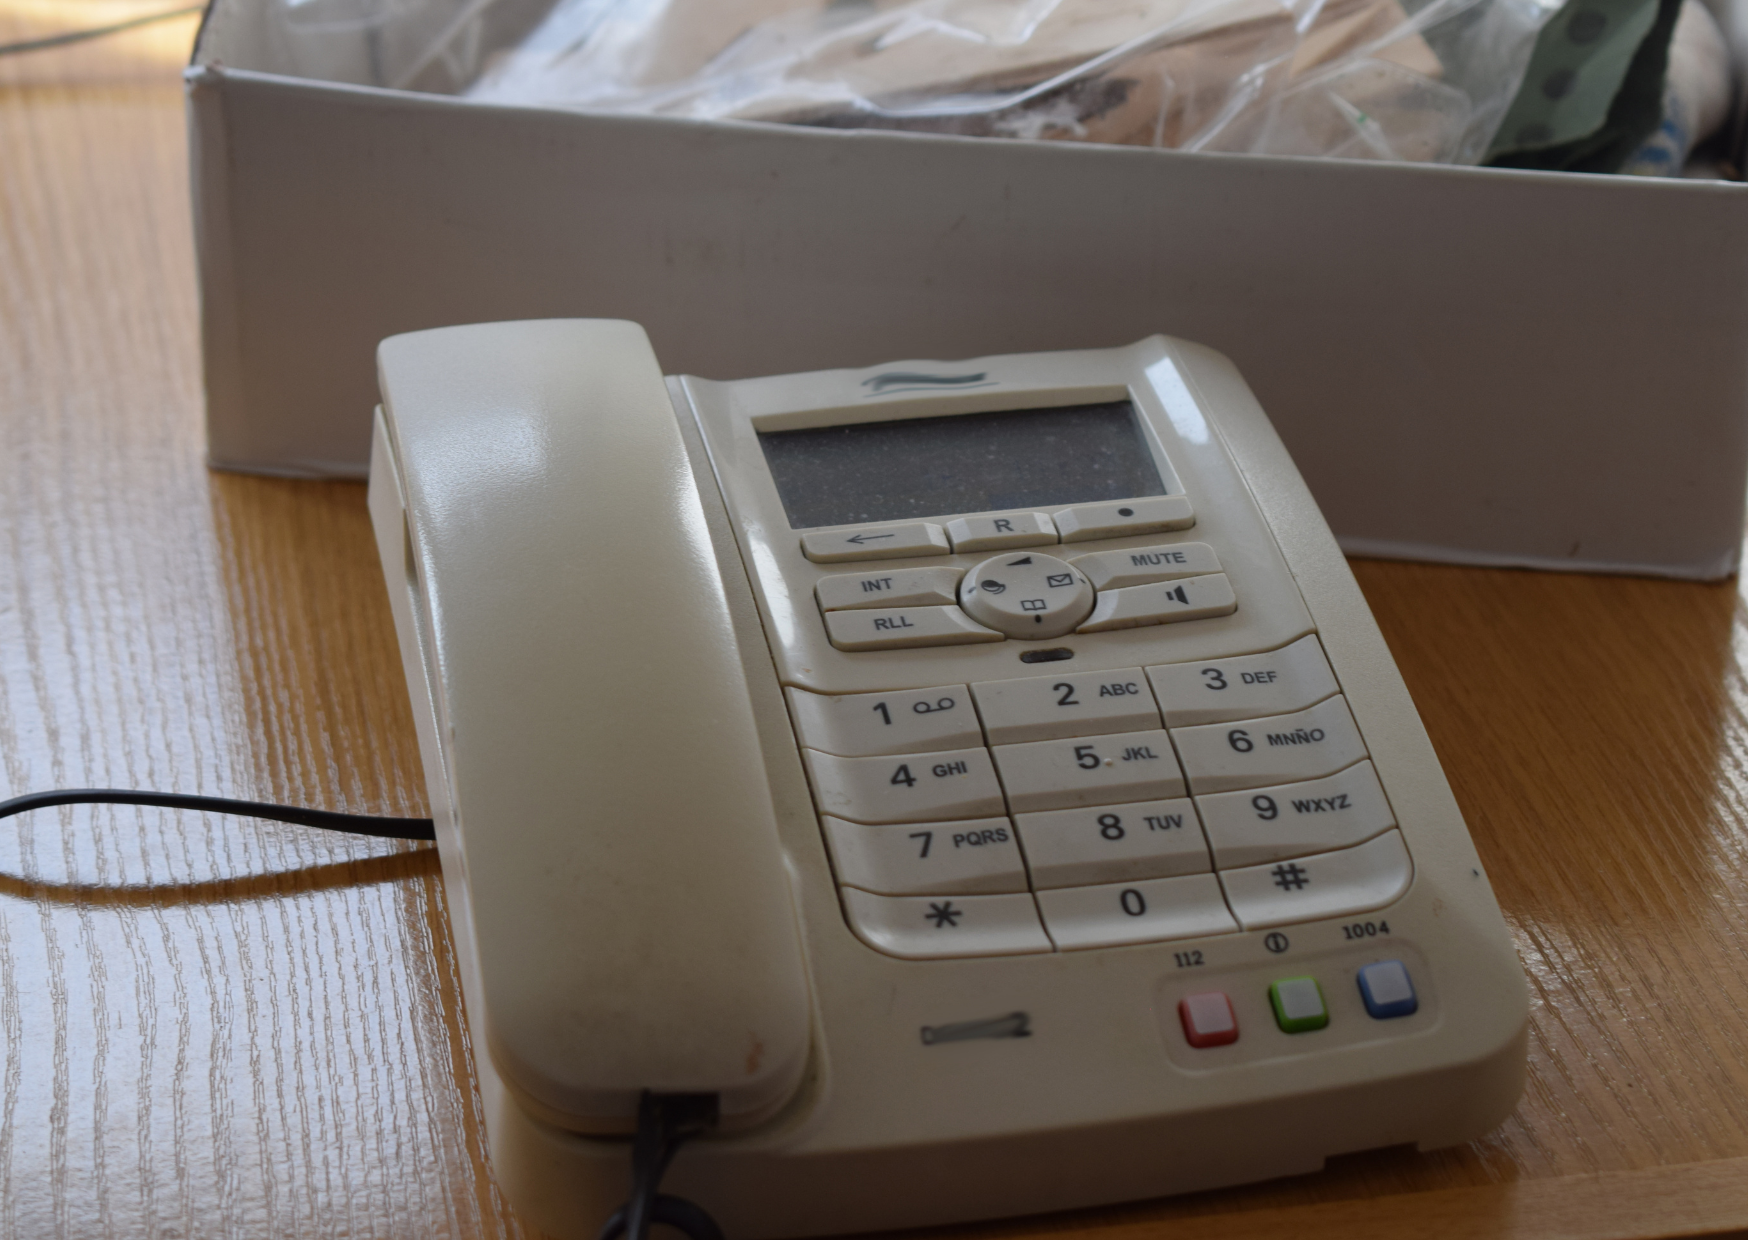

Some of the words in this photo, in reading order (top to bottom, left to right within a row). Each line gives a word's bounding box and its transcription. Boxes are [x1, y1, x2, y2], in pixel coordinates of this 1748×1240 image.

[994, 518, 1015, 533] R
[1130, 551, 1187, 567] MUTE
[861, 577, 892, 593] INT
[873, 615, 914, 631] RLL
[1201, 668, 1228, 691] 3
[1240, 670, 1277, 685] DEF
[1052, 682, 1080, 707] 2
[1099, 682, 1139, 698] ABC
[873, 702, 892, 726] 1
[1227, 729, 1254, 753] 6
[1266, 728, 1325, 747] MNÑO
[1073, 745, 1101, 770] 5
[1121, 746, 1159, 762] JKL
[890, 764, 917, 788] 4
[931, 760, 968, 778] GHI
[1251, 794, 1279, 821] 9
[1291, 793, 1351, 814] WXYZ
[1097, 813, 1125, 841] 8
[1143, 814, 1182, 831] TUV
[909, 831, 933, 859] 7
[952, 827, 1009, 849] PQRS
[1119, 888, 1147, 917] 0
[1342, 920, 1390, 940] 1004
[1173, 950, 1205, 968] 112
